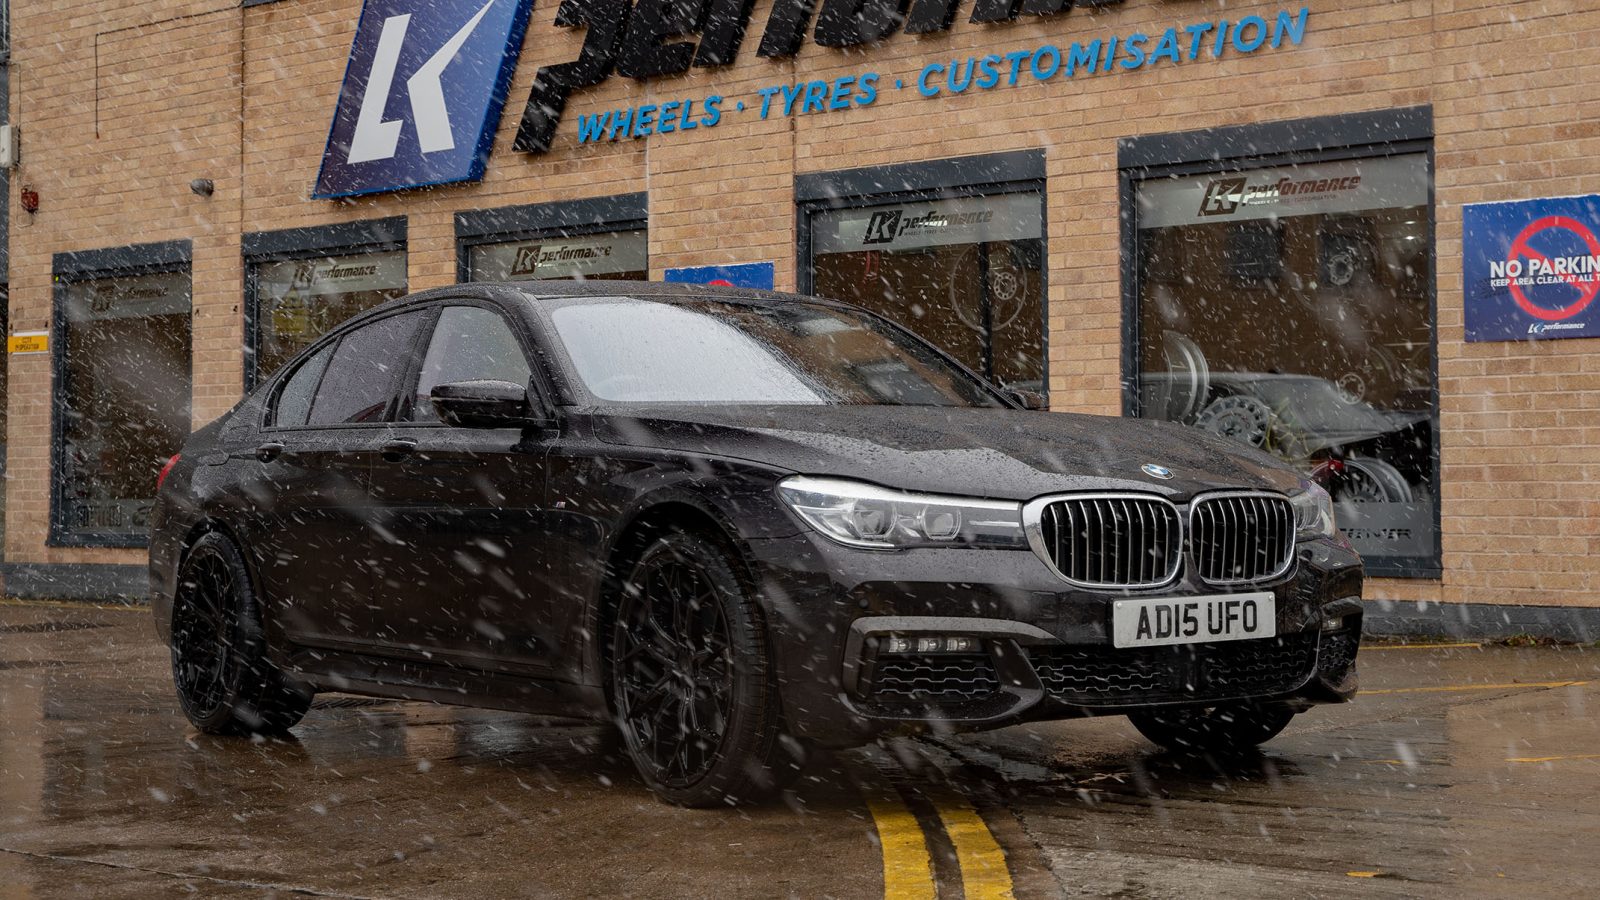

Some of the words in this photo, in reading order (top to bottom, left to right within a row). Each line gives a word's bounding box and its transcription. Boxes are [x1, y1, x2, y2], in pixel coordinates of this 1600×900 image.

[578, 95, 724, 144] WHEELS
[757, 72, 880, 120] TYRES
[917, 7, 1309, 98] CUSTOMISATION
[1241, 176, 1361, 207] performance
[898, 210, 994, 237] performance
[538, 246, 612, 266] performance
[1490, 260, 1522, 278] NO
[1529, 255, 1600, 275] PARKIN
[1491, 278, 1511, 287] KEEP
[1513, 276, 1535, 285] AREA
[1537, 275, 1564, 284] CLEAR
[1566, 274, 1577, 283] AT
[1579, 273, 1594, 282] ALL
[1541, 322, 1586, 333] performance
[1136, 604, 1199, 640] AD15
[1207, 600, 1258, 635] UFO
